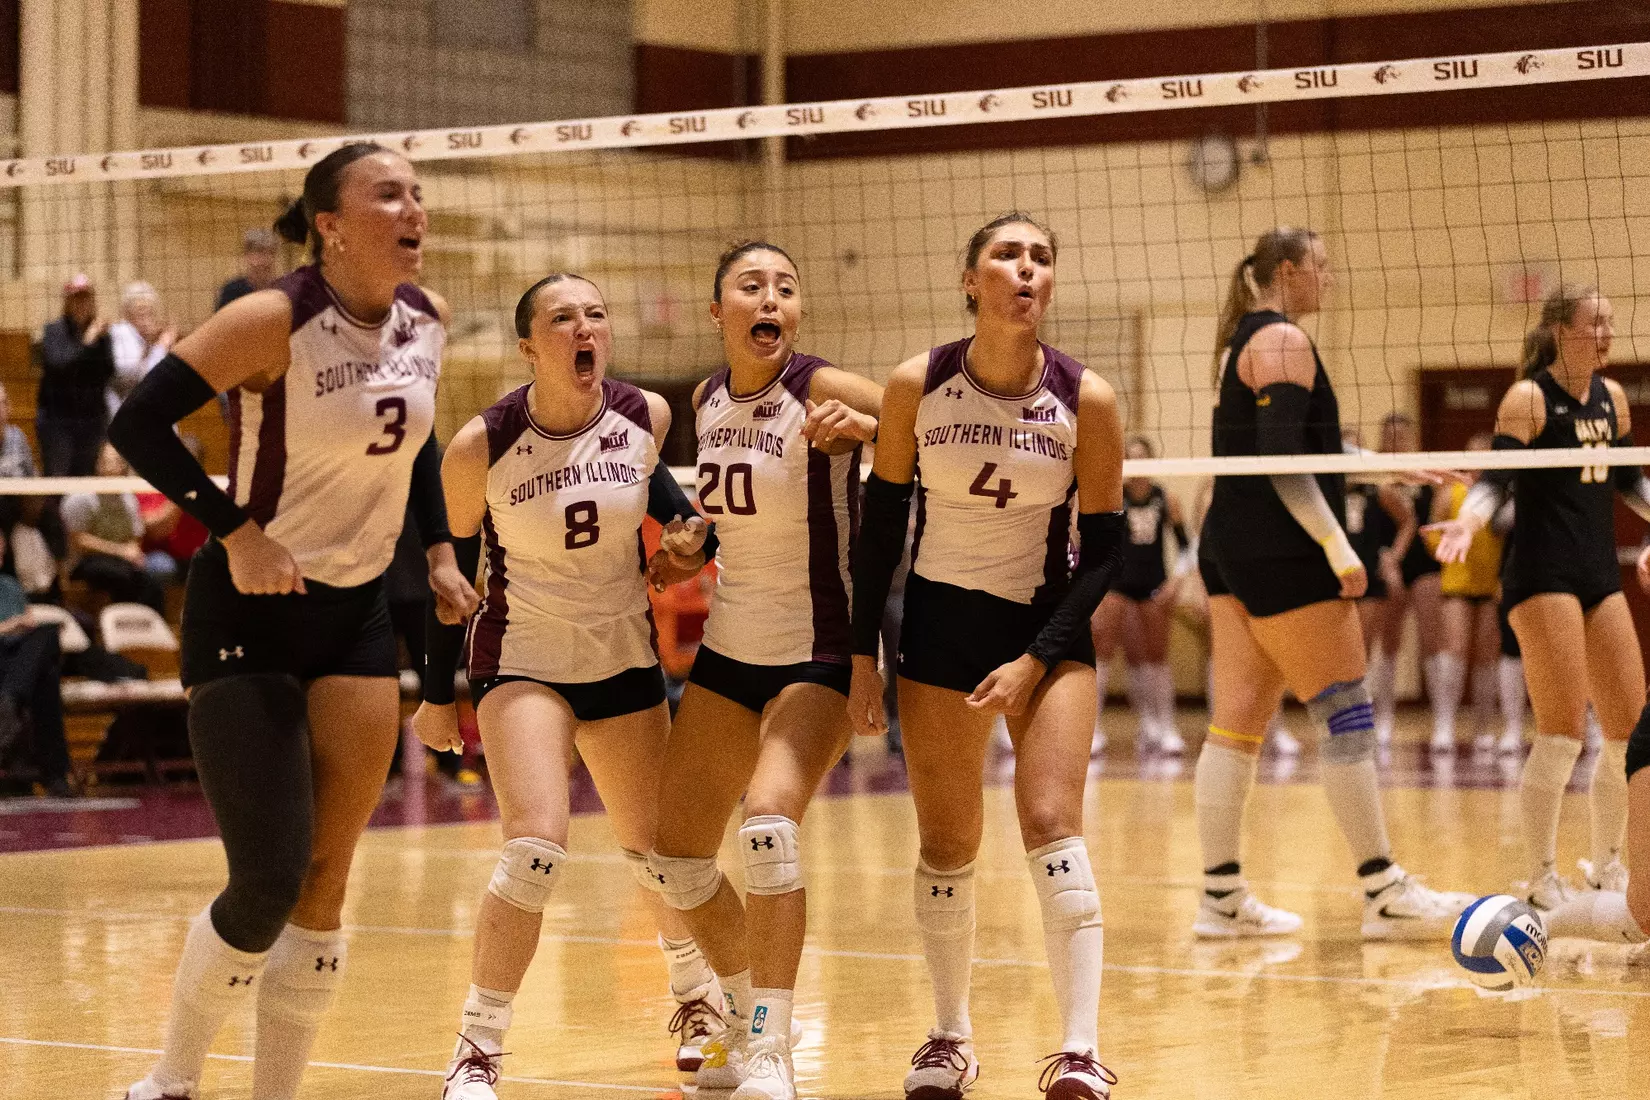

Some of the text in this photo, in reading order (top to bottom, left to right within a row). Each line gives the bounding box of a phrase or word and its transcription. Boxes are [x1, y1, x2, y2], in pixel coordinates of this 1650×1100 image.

[46, 49, 1623, 176] SIU SIU SIU SIU SIU SIU SIU SIU SIU SIU SIU SIU SIU
[366, 397, 407, 456] 3
[924, 423, 1069, 461] SOUTHERN ILLINOIS
[510, 461, 640, 507] SOUTHERN ILLINOIS
[698, 462, 757, 516] 20
[969, 462, 1019, 509] 4
[565, 500, 601, 550] 8
